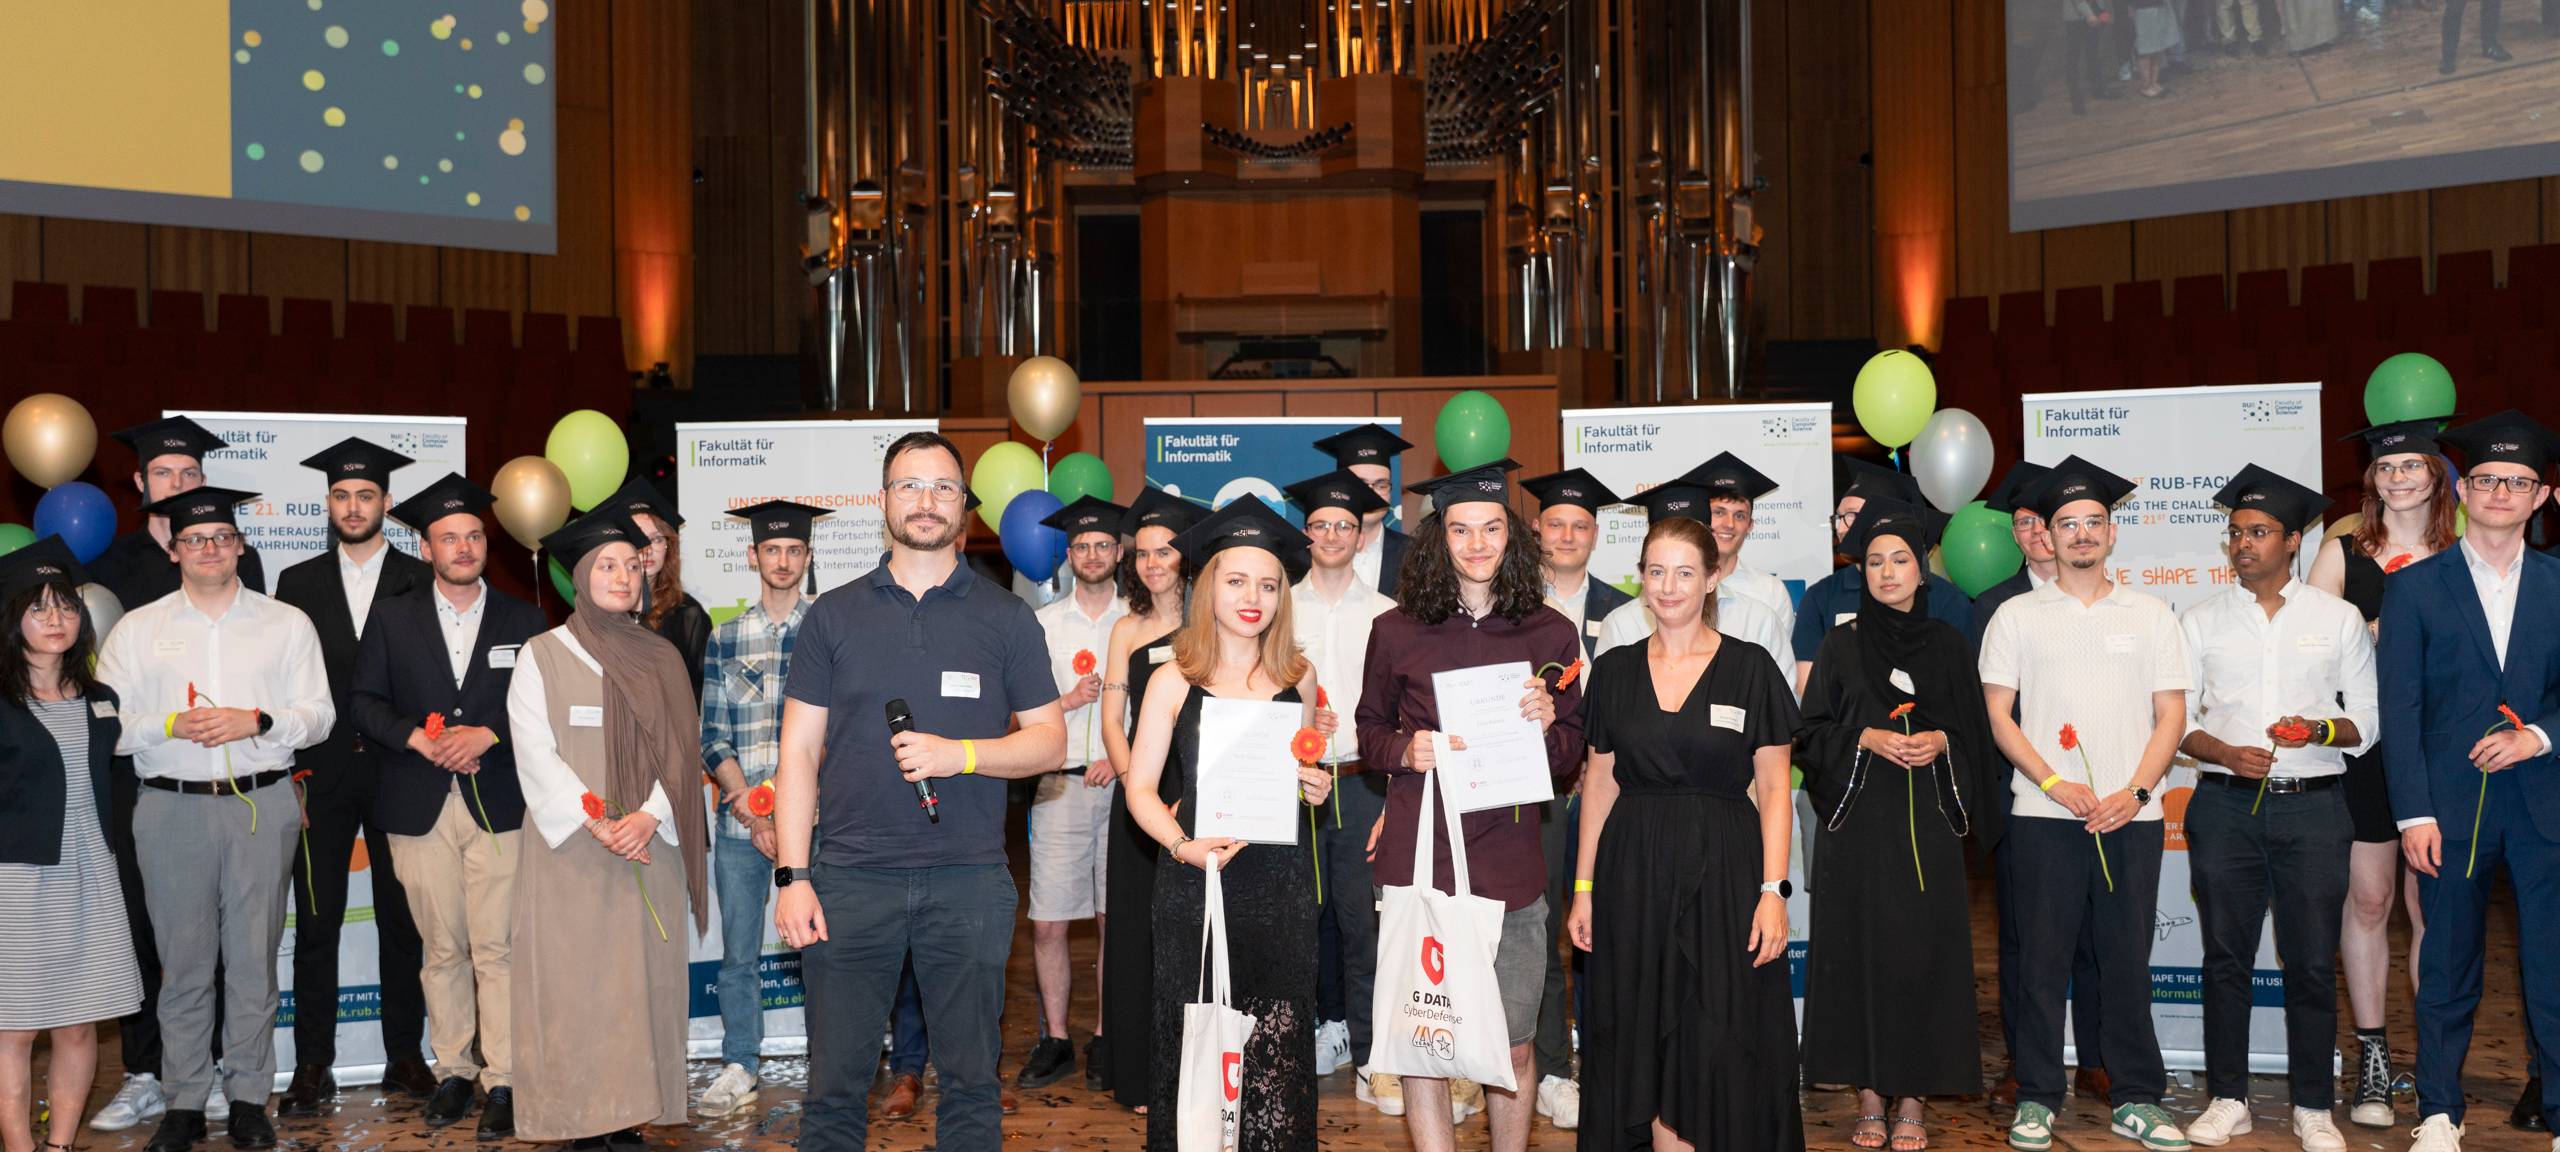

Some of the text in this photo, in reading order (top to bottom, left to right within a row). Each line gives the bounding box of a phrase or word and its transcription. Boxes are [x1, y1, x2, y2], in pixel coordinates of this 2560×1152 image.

[2046, 407, 2129, 422] Fakultät für
[256, 430, 278, 443] für
[1584, 424, 1661, 438] Fakultät für
[2046, 424, 2120, 438] Informatik
[699, 438, 775, 451] Fakultät für
[1165, 434, 1240, 447] Fakultät für
[1584, 440, 1652, 454] Informatik
[699, 456, 767, 467] Informatik
[1165, 451, 1232, 463] Informatik
[795, 495, 881, 508] FORSCHUN
[2111, 501, 2140, 511] CING
[2144, 501, 2168, 510] THE
[256, 503, 280, 516] 21.
[286, 503, 328, 516] RUB-
[1754, 515, 1776, 525] elds
[2115, 515, 2139, 525] THE
[2170, 514, 2228, 524] CENTURY
[244, 526, 265, 536] DIE
[269, 527, 328, 537] HERAUSF
[2142, 566, 2198, 585] SHAPE
[2176, 974, 2195, 984] THE
[2266, 977, 2283, 986] US!
[357, 992, 373, 1001] MIT
[775, 995, 789, 1004] du
[1413, 990, 1452, 1010] G DATA
[1403, 1003, 1463, 1025] CyberDefense
[1412, 1024, 1455, 1061] 40
